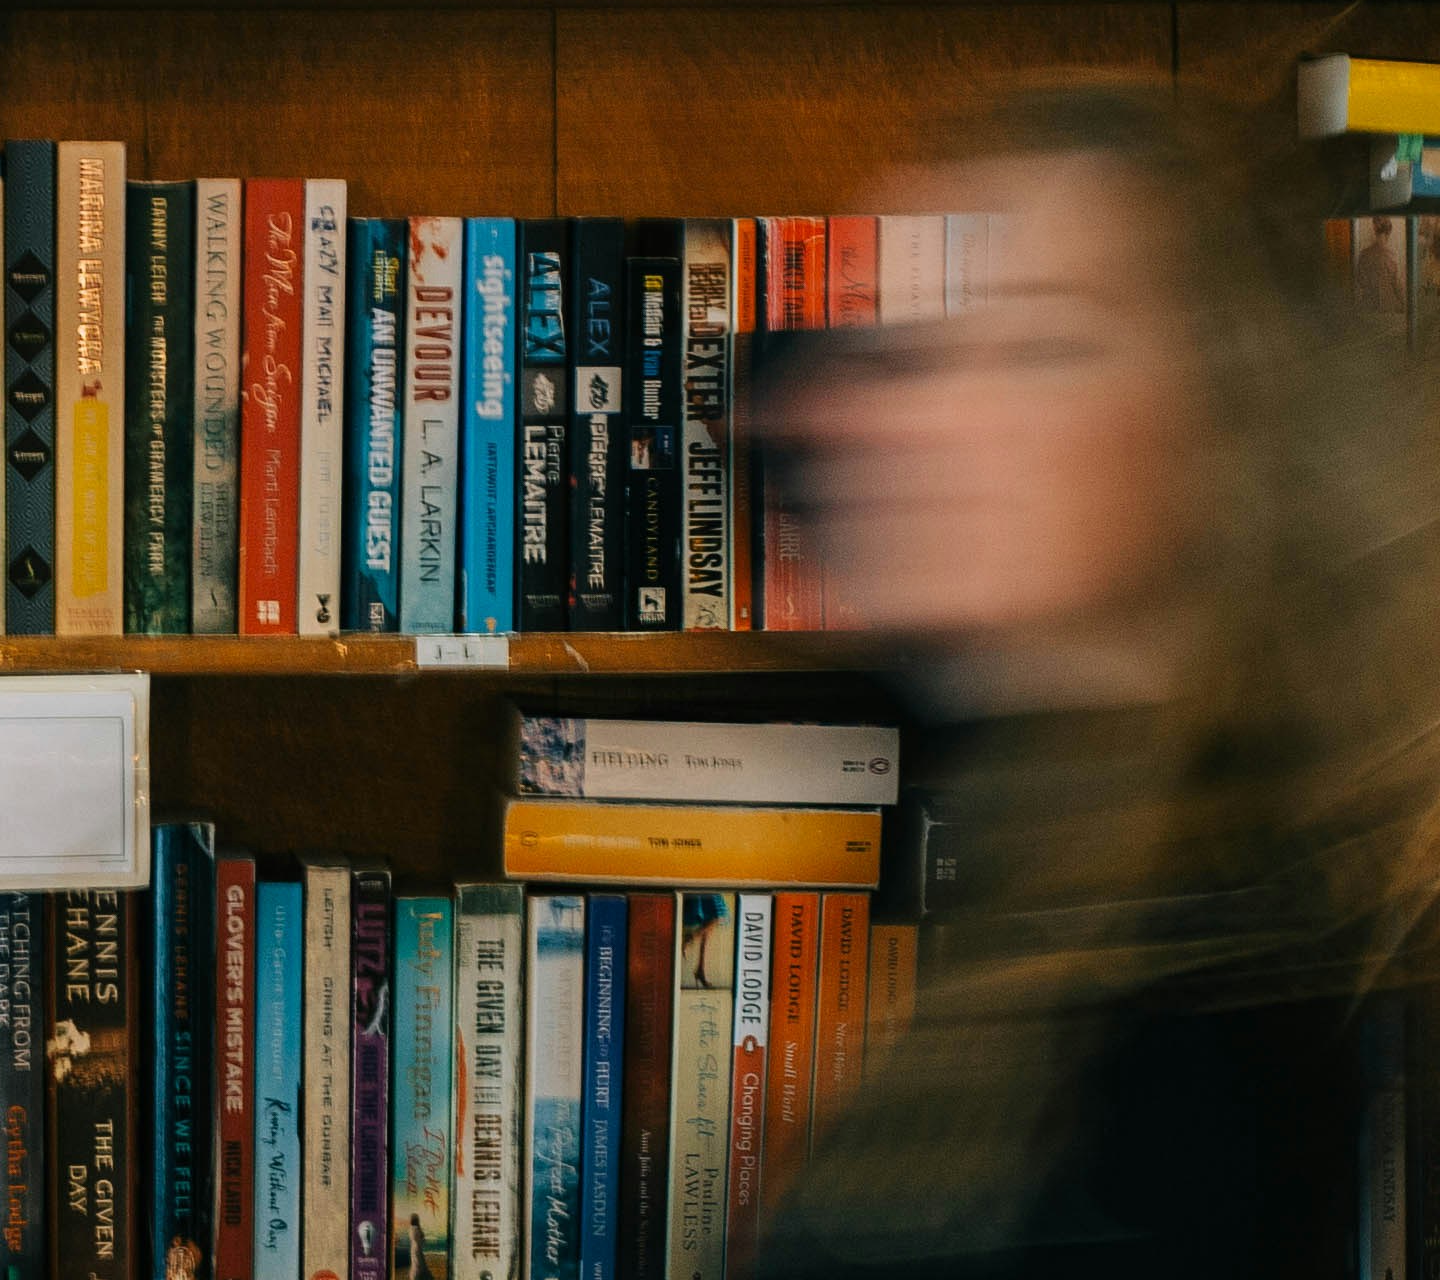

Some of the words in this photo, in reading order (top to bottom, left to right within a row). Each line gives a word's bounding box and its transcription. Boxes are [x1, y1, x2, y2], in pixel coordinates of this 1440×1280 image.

[413, 287, 450, 402] DEVOUR
[687, 442, 724, 493] JEFF
[689, 499, 725, 598] LINDSAY
[473, 939, 506, 972] THE
[473, 979, 506, 1035] GIVEN
[471, 1043, 504, 1079] DAY
